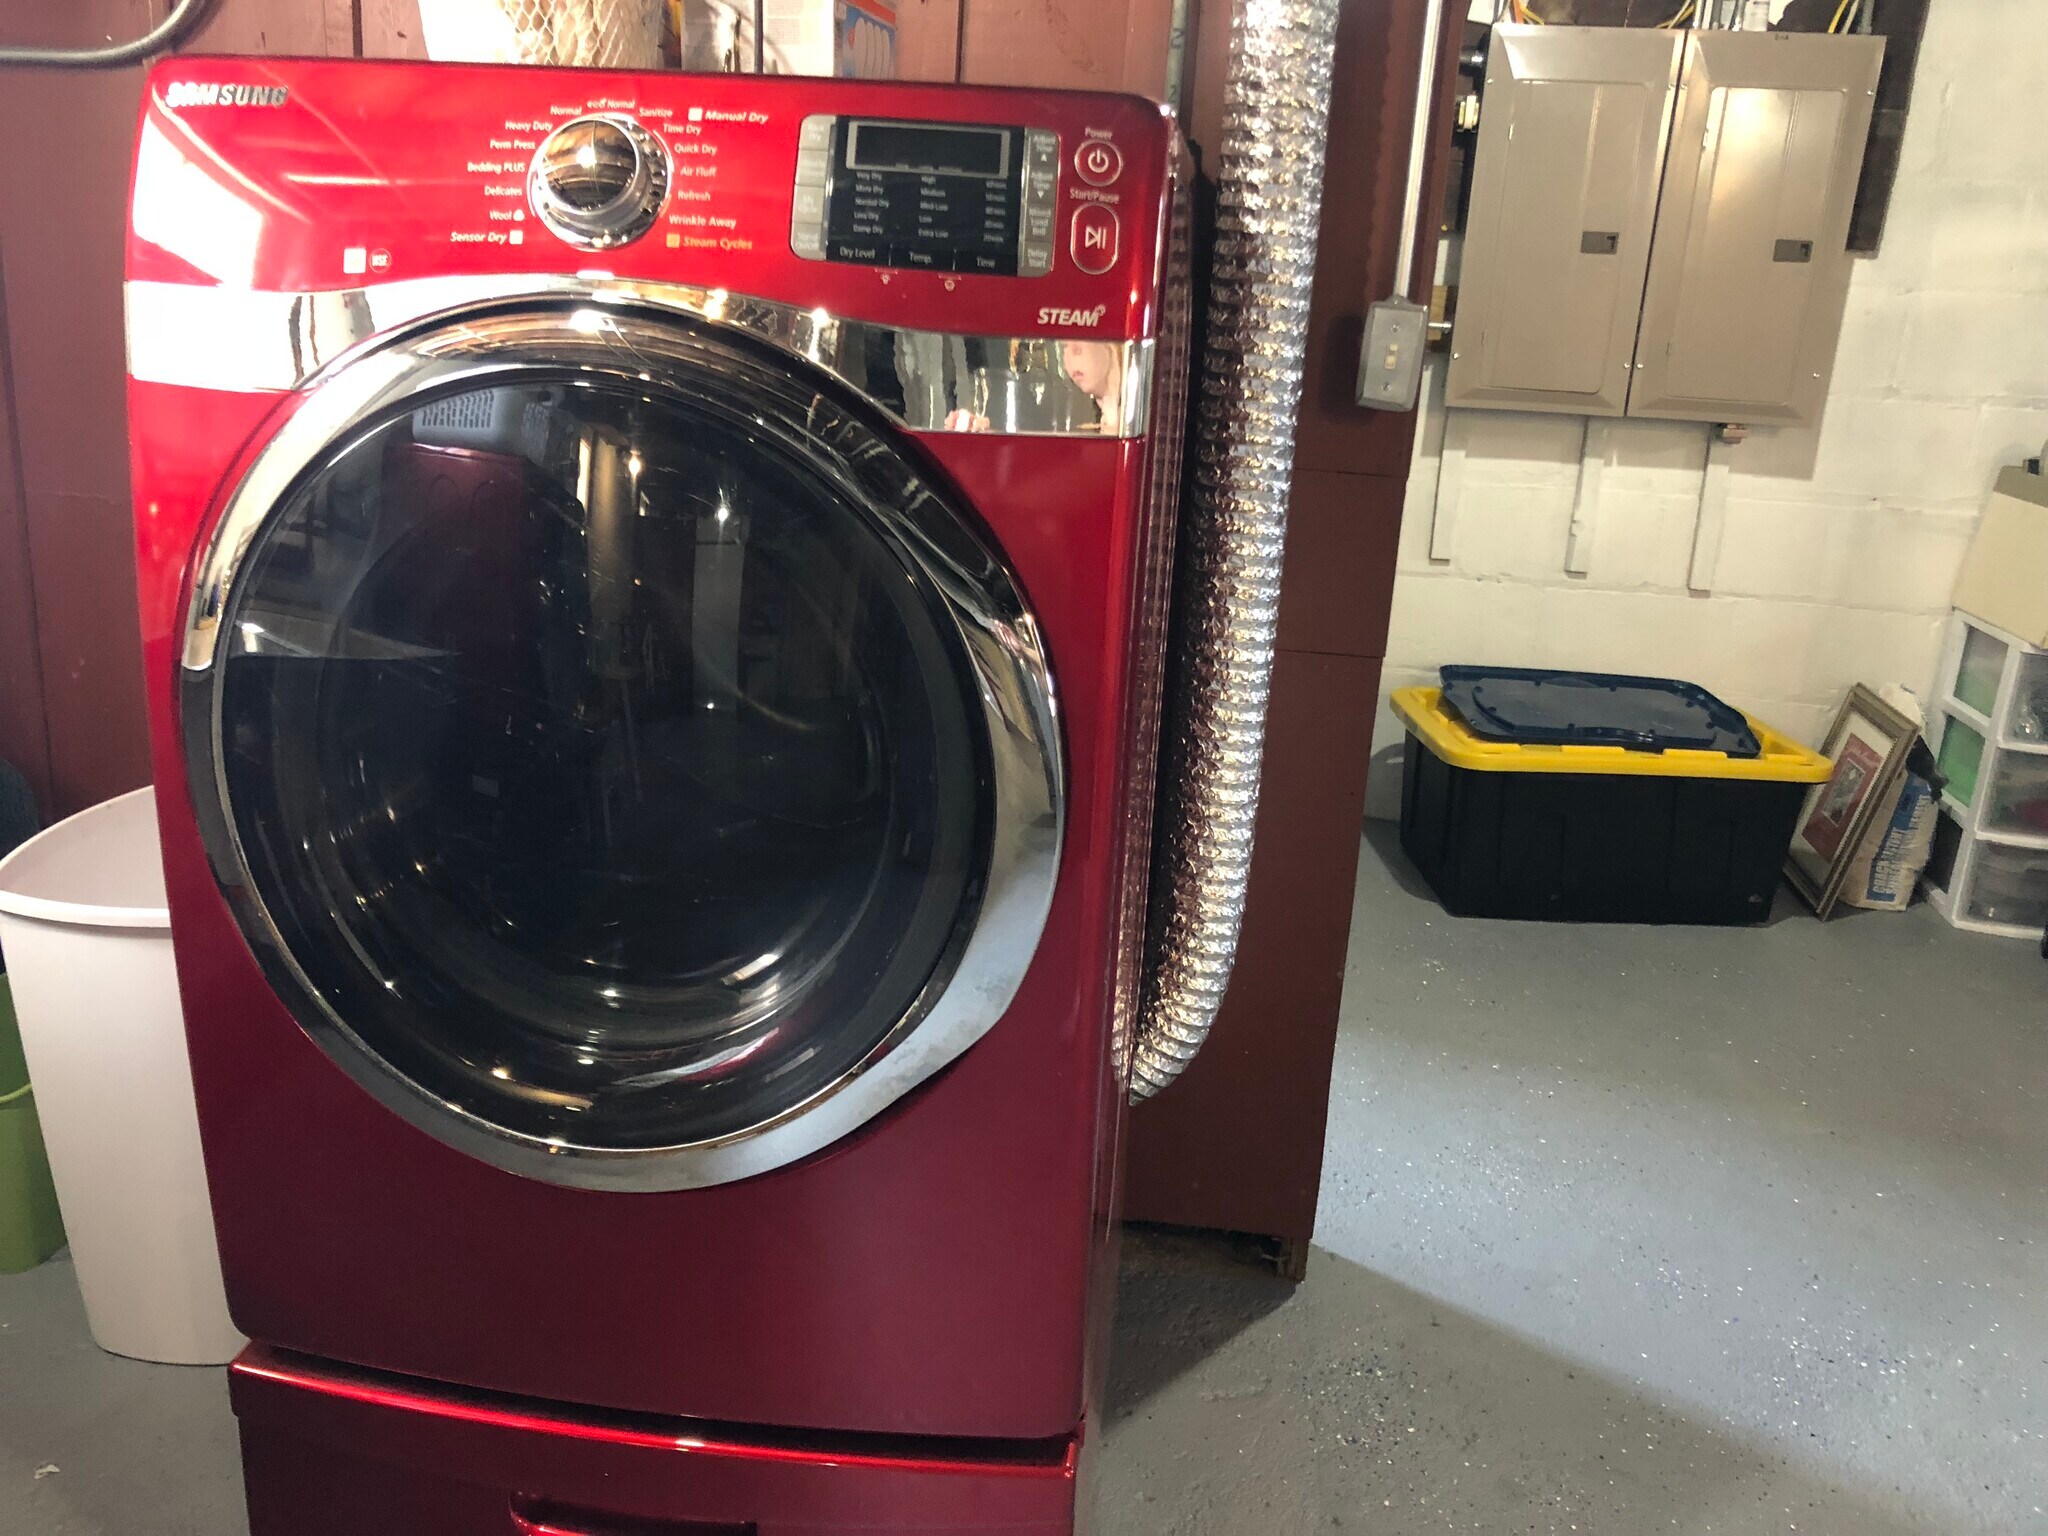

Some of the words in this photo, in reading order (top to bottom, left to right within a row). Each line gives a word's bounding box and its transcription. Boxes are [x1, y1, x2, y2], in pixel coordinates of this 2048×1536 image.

[166, 82, 288, 108] SAMSUNG
[608, 100, 636, 109] Normal
[551, 106, 582, 116] Normal
[639, 108, 673, 118] Sanitize
[706, 111, 746, 121] Manual
[750, 113, 768, 124] Dry
[505, 121, 531, 132] Heavy
[532, 121, 553, 131] Duty
[664, 124, 684, 134] Time
[686, 124, 701, 136] Dry
[1085, 127, 1113, 140] Power
[490, 139, 511, 150] Perm
[514, 140, 536, 149] Press
[674, 144, 699, 154] Quick
[702, 144, 717, 155] Dry
[467, 162, 502, 175] Bedding
[504, 162, 526, 172] PLUS
[680, 167, 693, 177] Air
[696, 167, 716, 177] Fluff
[871, 173, 882, 181] Dry
[484, 186, 522, 196] Delicates
[855, 184, 871, 192] More
[873, 185, 884, 195] Dry
[920, 188, 946, 198] Medium
[678, 191, 711, 201] Refresh
[1069, 188, 1120, 204] Start/Pause
[855, 197, 877, 206] Normal
[878, 199, 890, 209] Dry
[935, 202, 948, 211] Low
[490, 210, 512, 221] Wool
[868, 211, 879, 221] Dry
[919, 215, 932, 223] Low
[669, 215, 706, 226] Wrinkle
[708, 216, 736, 229] Away
[853, 224, 871, 234] Damp
[872, 225, 883, 235] Dry
[935, 229, 949, 238] Low
[450, 231, 486, 242] Sensor
[487, 232, 507, 245] Dry
[684, 237, 717, 248] Steam
[720, 238, 752, 250] Cycles
[839, 246, 853, 258] Dry
[855, 248, 876, 259] Level
[976, 256, 996, 268] Time
[1037, 307, 1100, 327] STEAM
